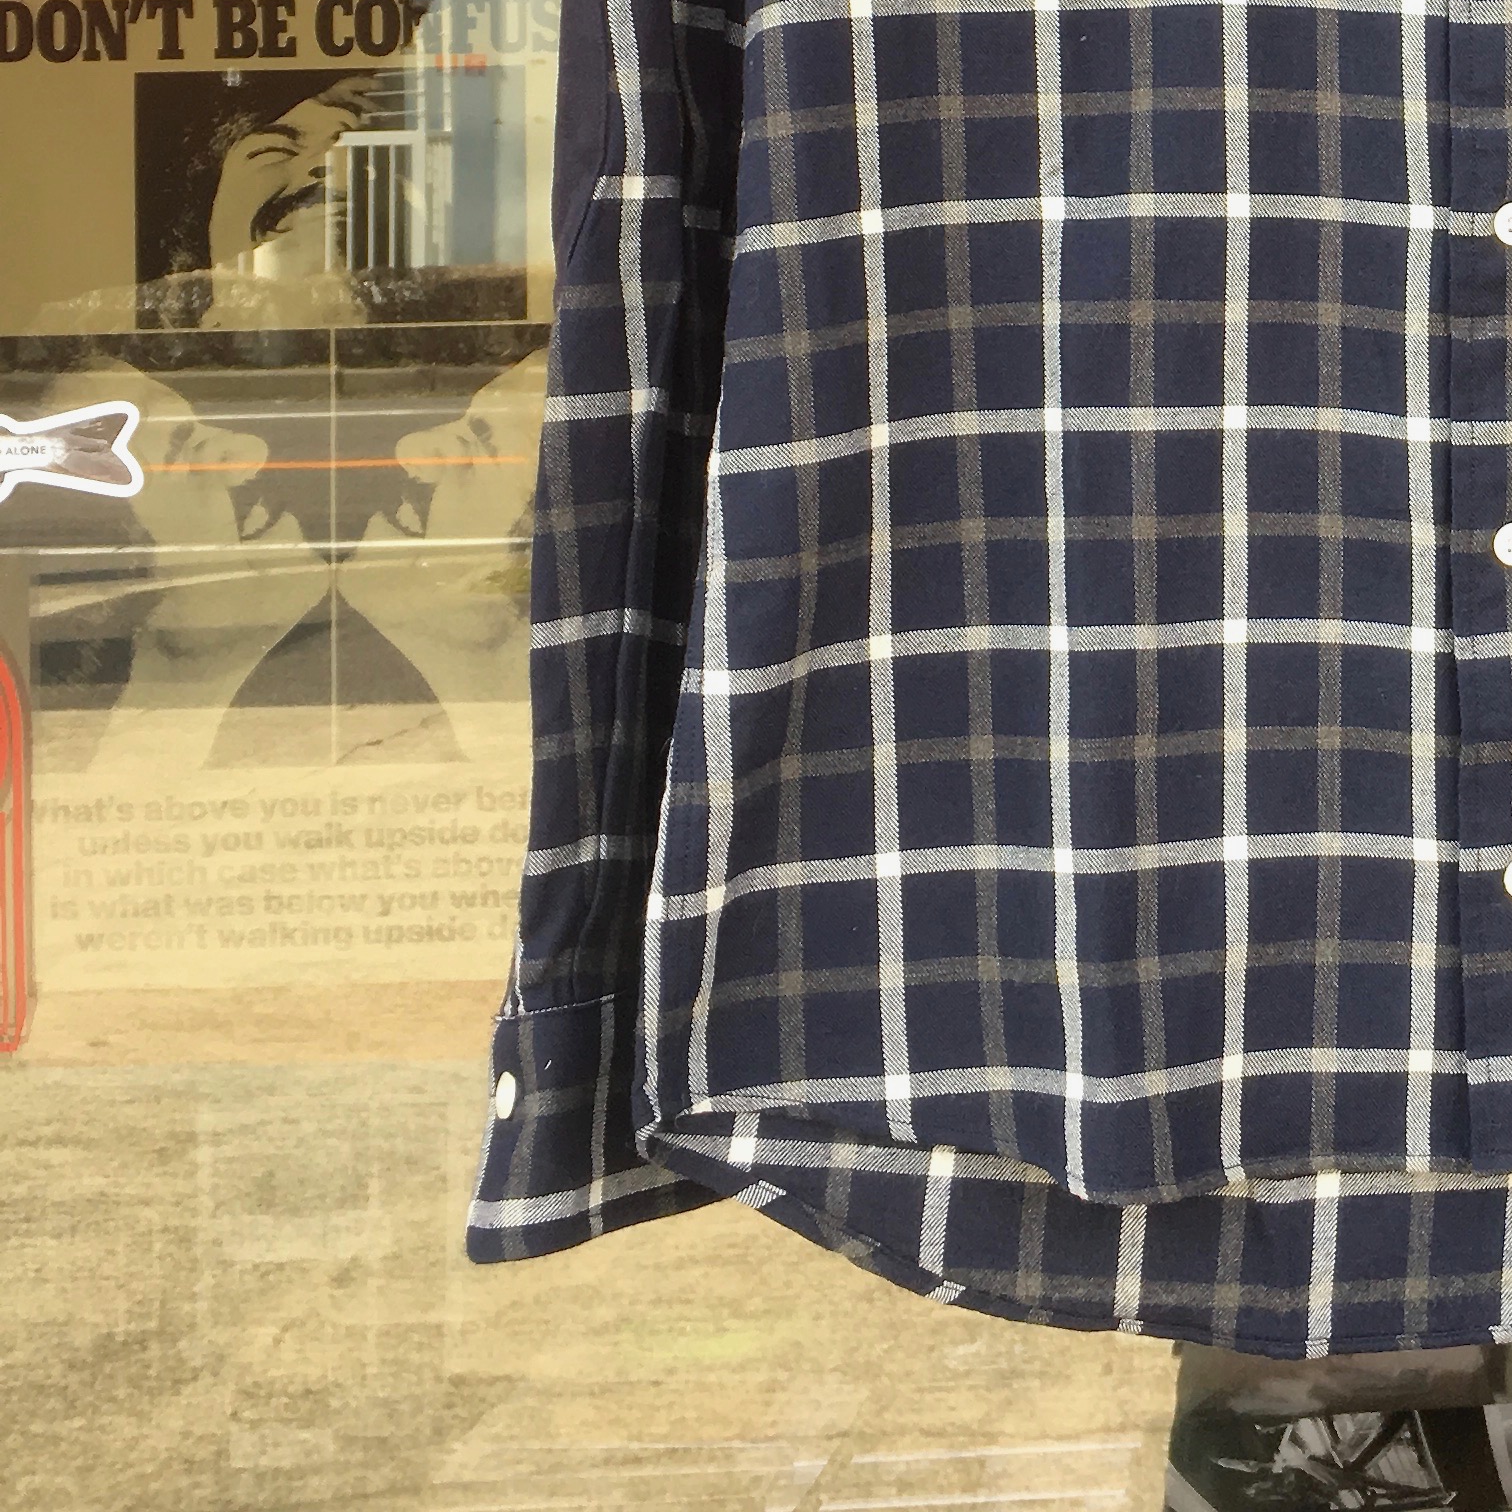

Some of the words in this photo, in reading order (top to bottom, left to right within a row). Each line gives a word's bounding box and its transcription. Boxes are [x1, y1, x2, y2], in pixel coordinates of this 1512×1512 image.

[5, 444, 47, 456] ALONE
[144, 794, 250, 822] above
[259, 795, 321, 823] you
[329, 789, 359, 816] is
[367, 791, 466, 816] never
[201, 830, 264, 858] you
[274, 822, 355, 851] walk
[364, 819, 481, 852] upside
[62, 860, 94, 888] in
[104, 858, 209, 888] which
[216, 861, 299, 885] case
[307, 854, 422, 882] what's
[49, 894, 79, 921] is
[87, 892, 176, 920] what
[182, 894, 256, 917] was
[376, 890, 440, 917] you
[74, 922, 209, 952] weren't
[216, 919, 354, 952] walking
[362, 916, 480, 950] upside
